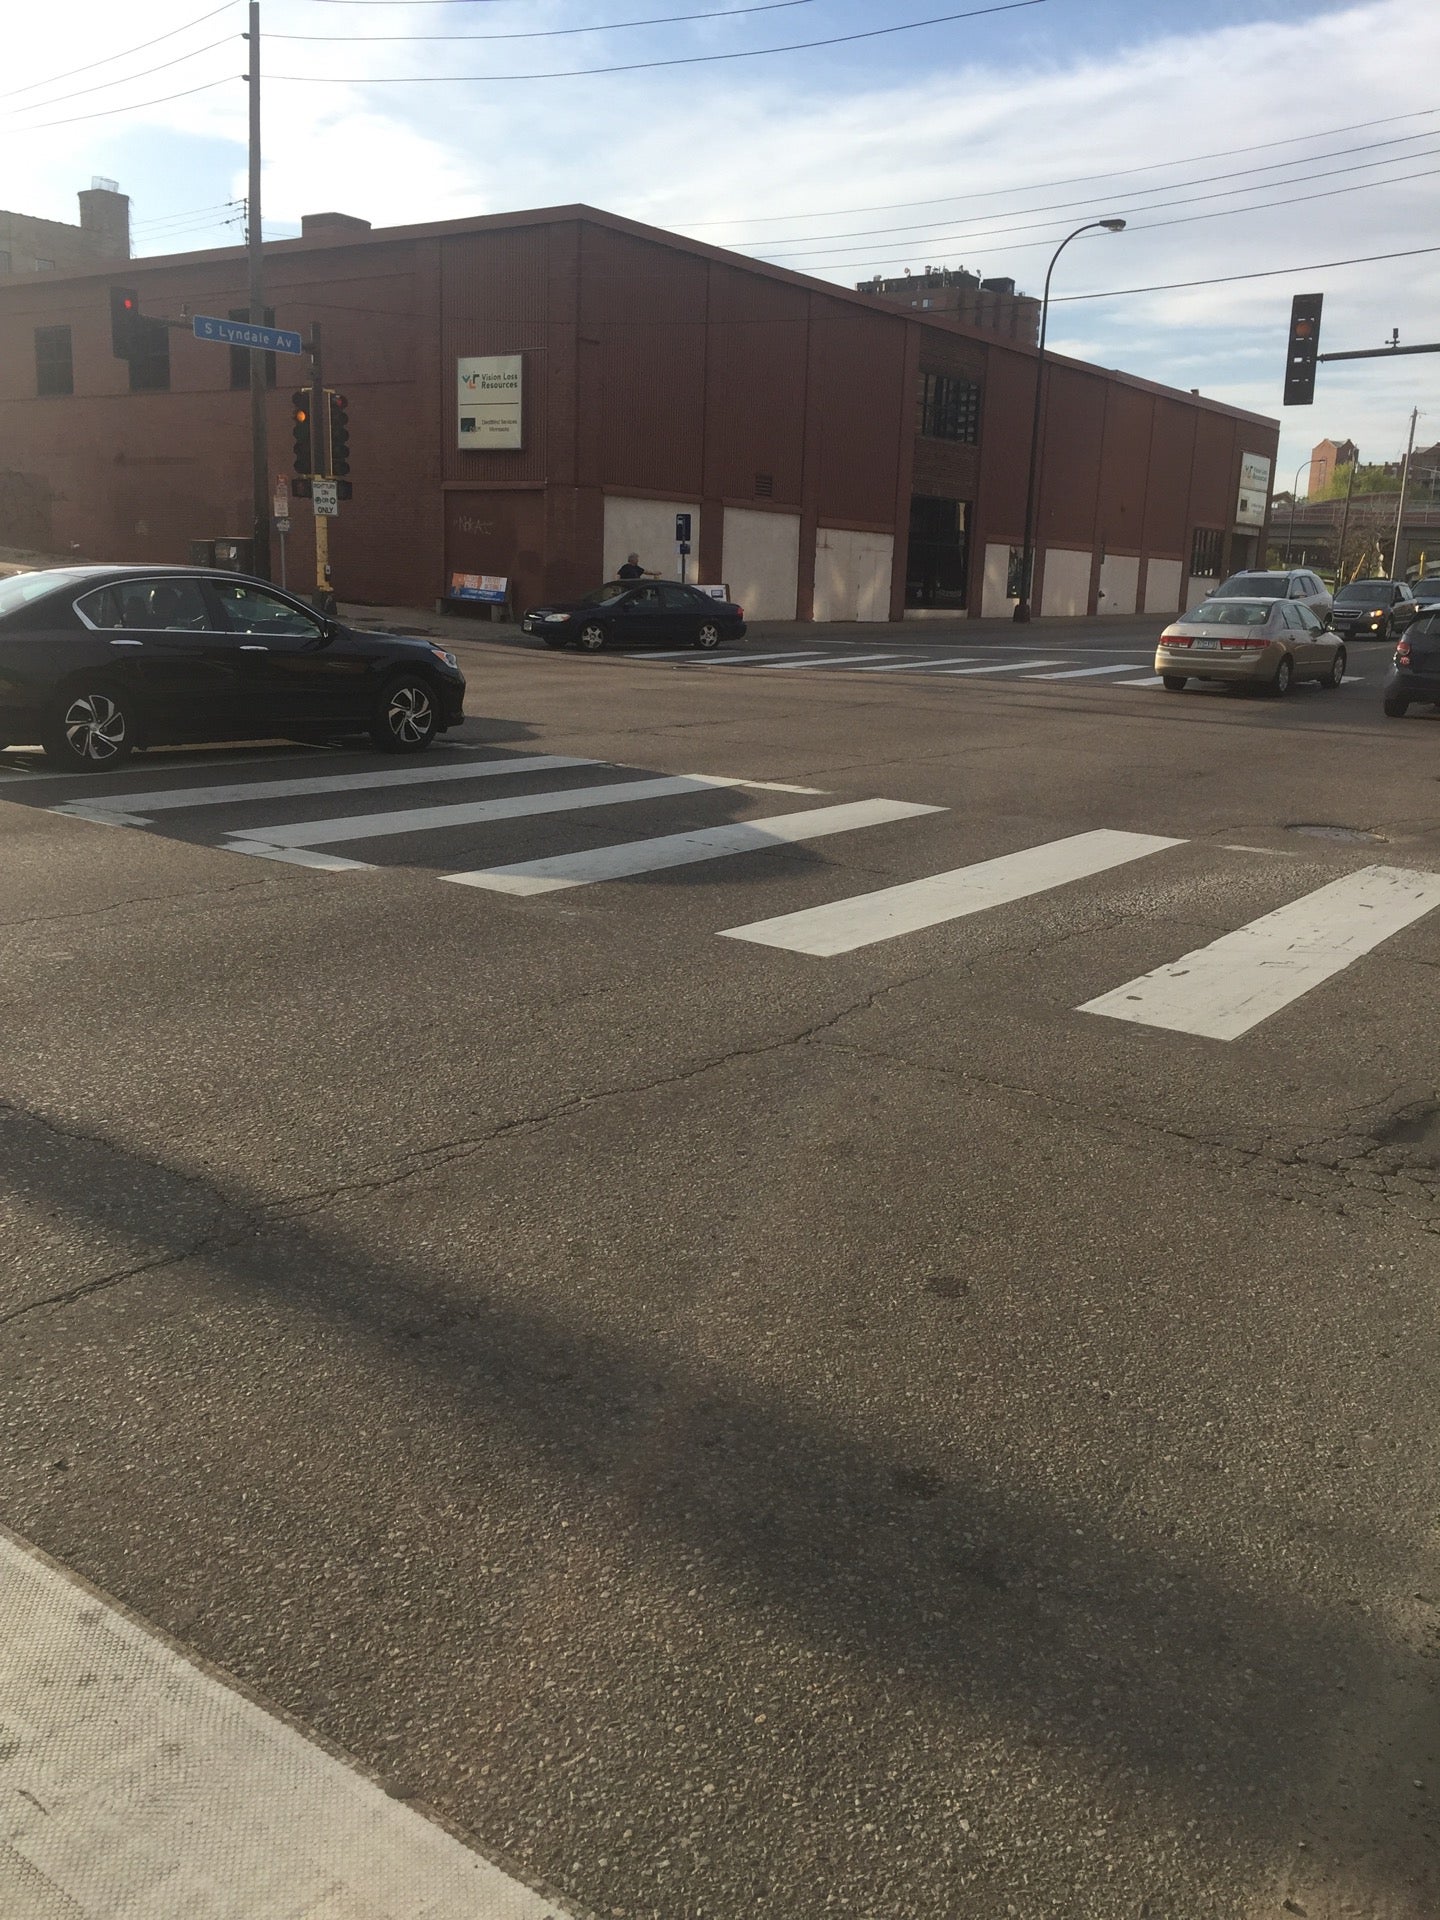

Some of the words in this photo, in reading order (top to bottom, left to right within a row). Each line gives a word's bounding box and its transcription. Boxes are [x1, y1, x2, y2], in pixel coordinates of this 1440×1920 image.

[205, 322, 212, 334] S
[219, 325, 270, 344] Lyndale
[276, 336, 292, 348] Av
[482, 381, 518, 389] Resources
